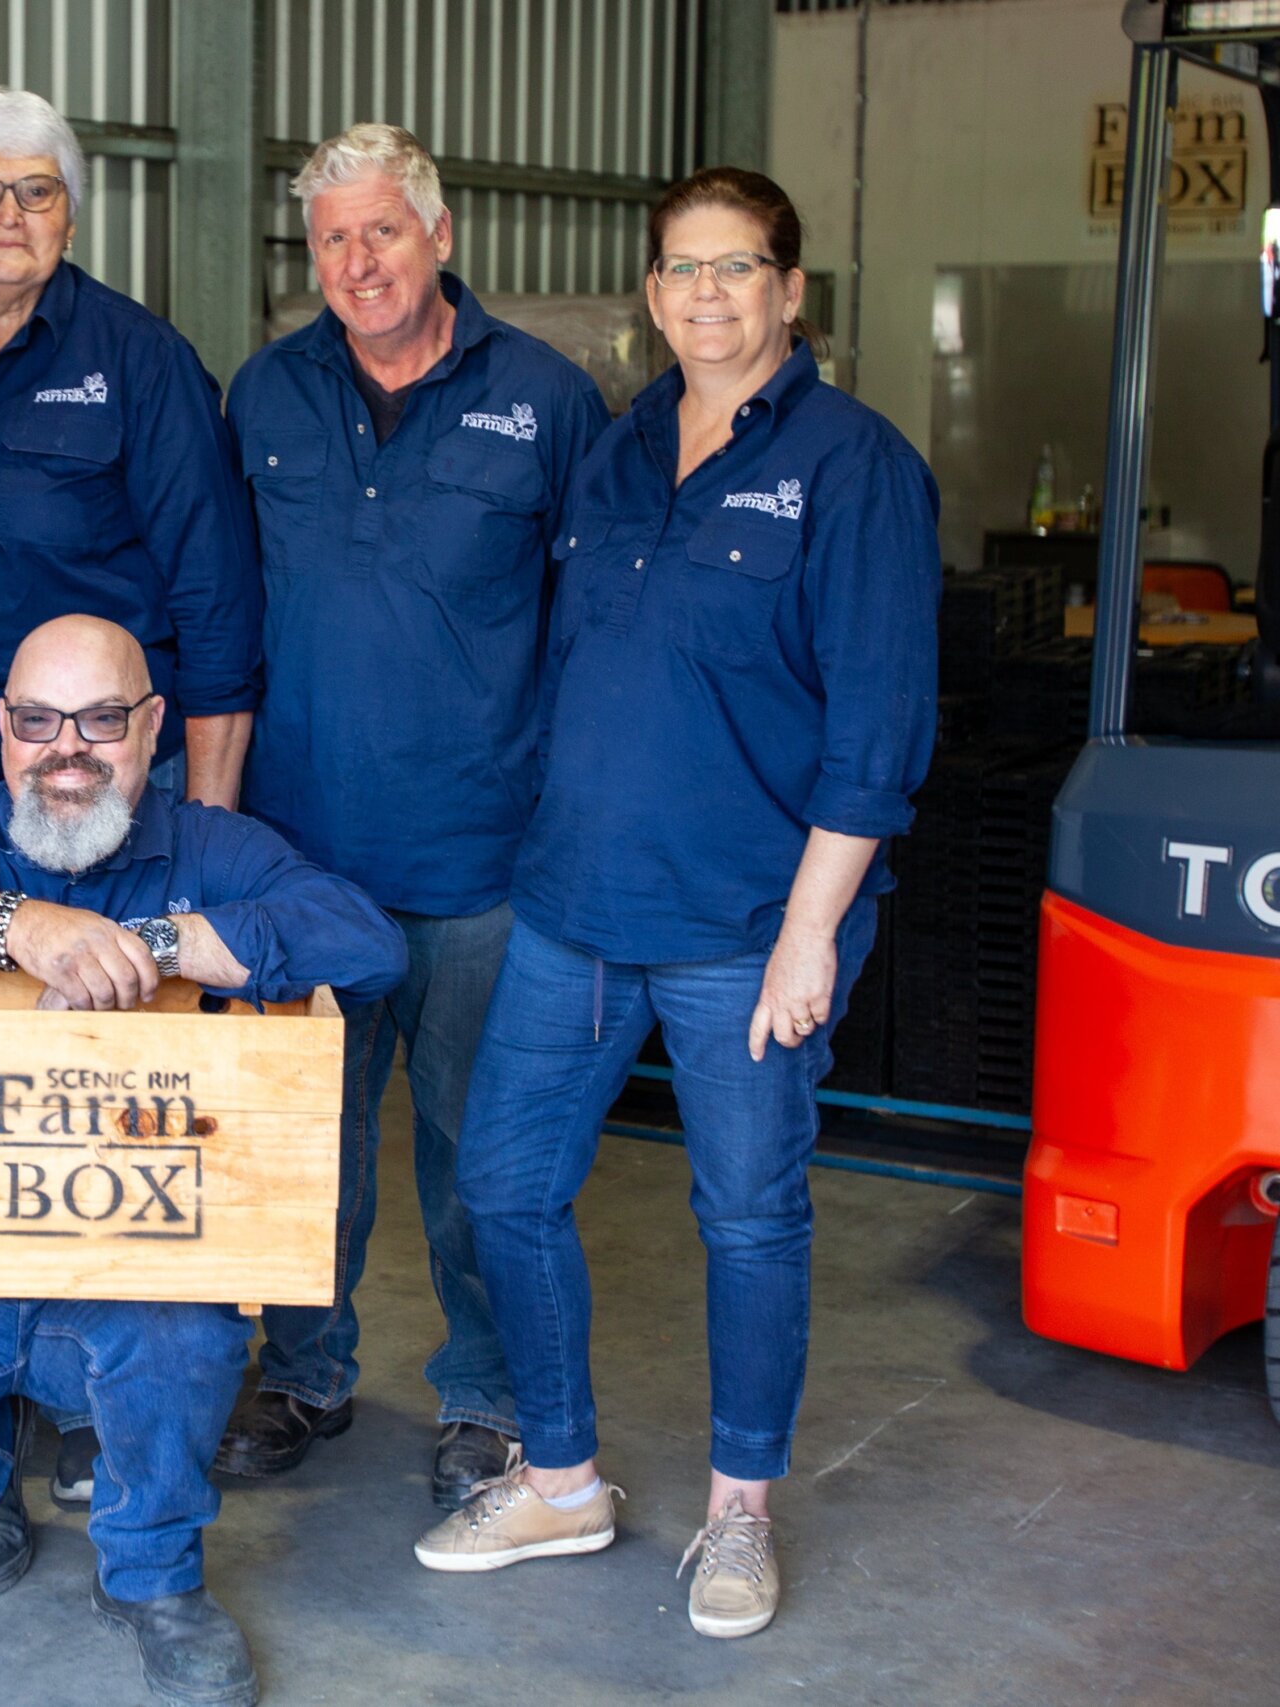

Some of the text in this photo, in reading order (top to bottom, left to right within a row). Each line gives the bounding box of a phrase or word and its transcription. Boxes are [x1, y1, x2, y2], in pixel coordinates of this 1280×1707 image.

[47, 1068, 191, 1091] SCENIC RIM
[4, 1162, 188, 1222] BOX
